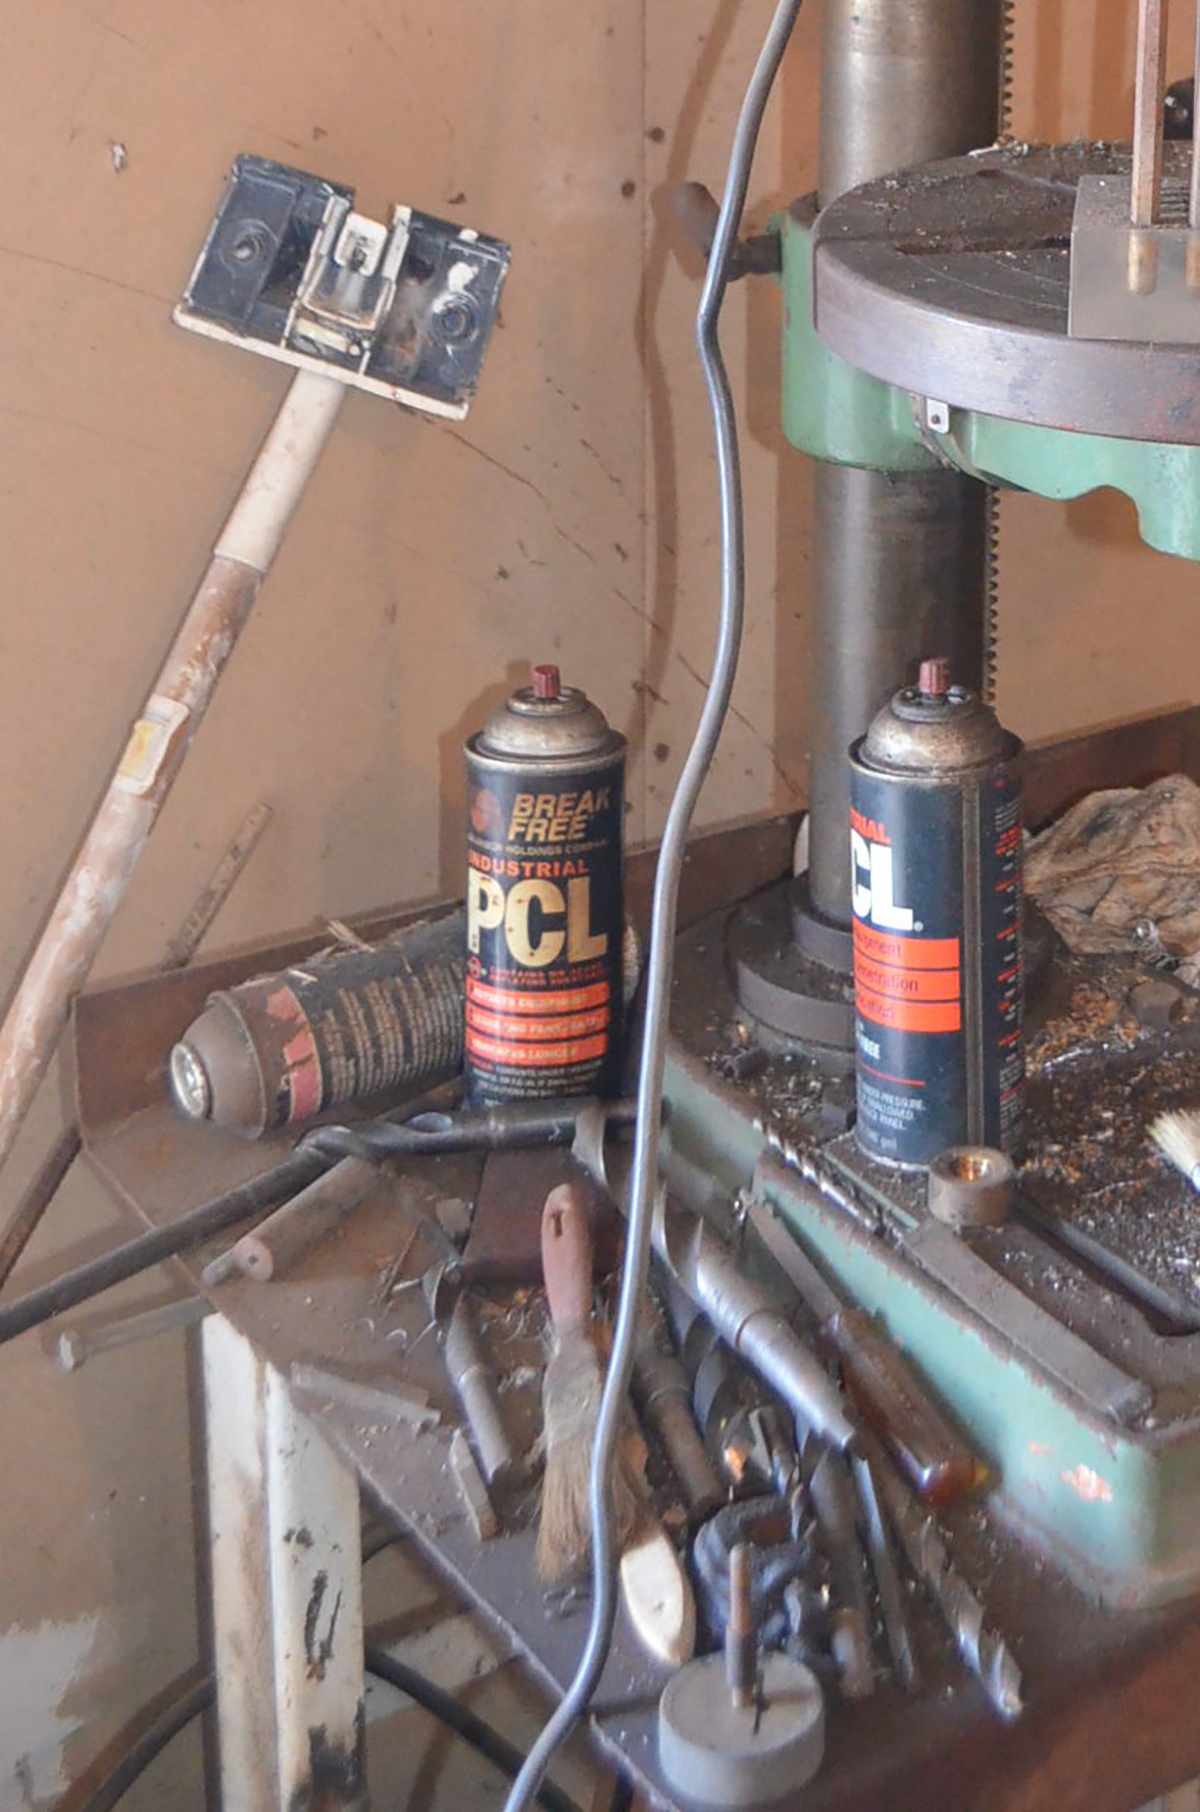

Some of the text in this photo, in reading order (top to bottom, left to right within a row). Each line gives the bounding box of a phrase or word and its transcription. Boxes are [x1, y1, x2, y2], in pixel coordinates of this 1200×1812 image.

[512, 788, 610, 818] BREAK
[508, 815, 588, 842] FREE
[468, 849, 590, 877] INDUSTRIAL
[468, 868, 608, 968] PCL
